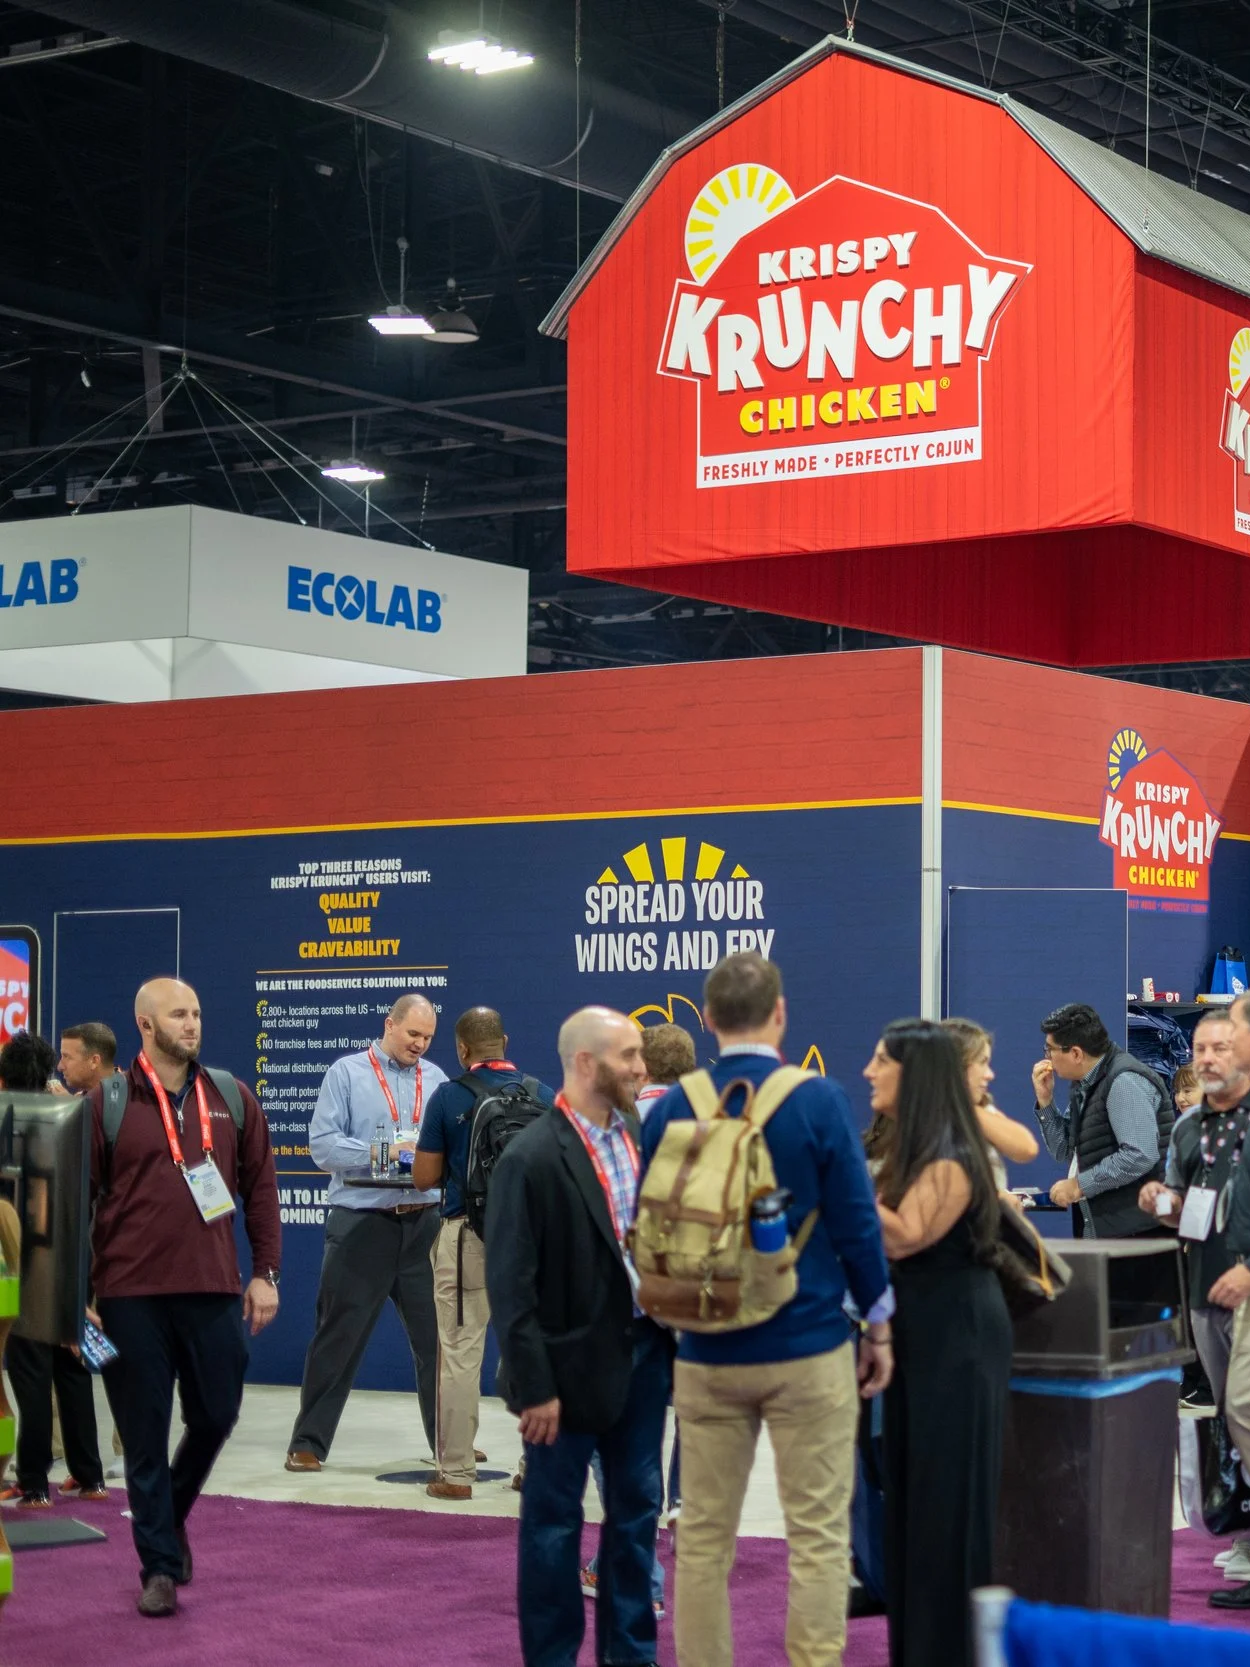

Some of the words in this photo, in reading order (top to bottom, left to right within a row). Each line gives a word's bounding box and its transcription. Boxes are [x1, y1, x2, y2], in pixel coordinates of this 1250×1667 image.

[758, 231, 918, 287] KRISPY
[666, 264, 1016, 392] KRUNCHY
[703, 461, 769, 482] FRESHLY
[775, 456, 818, 475] MADE
[835, 445, 920, 469] PERFECTLY
[925, 438, 976, 461] CAJUN
[1135, 781, 1189, 805] KRISPY
[1102, 794, 1220, 865] KRUNCHY
[299, 863, 319, 875] TOP
[320, 861, 353, 874] THREE
[354, 858, 402, 872] REASONS
[270, 876, 309, 889] KRISPY
[365, 872, 399, 885] USERS
[400, 870, 431, 884] VISIT:
[319, 891, 380, 914] QUALITY
[584, 882, 686, 925] SPREAD
[691, 880, 764, 921] YOUR
[327, 917, 371, 934] VALUE
[298, 939, 401, 958] CRAVEABILITY
[575, 931, 658, 973] WINGS
[662, 930, 719, 971] AND
[256, 980, 269, 991] WE
[270, 979, 286, 991] ARE
[287, 979, 304, 991] THE
[304, 978, 362, 990] FOODSERVICE
[363, 977, 406, 989] SOLUTION
[407, 977, 425, 988] FOR
[426, 976, 447, 987] YOU:
[262, 1006, 287, 1018] 2,800+
[288, 1004, 319, 1016] locations
[320, 1006, 344, 1016] across
[345, 1003, 357, 1015] the
[358, 1004, 368, 1014] US
[376, 1003, 391, 1014] twic
[432, 1003, 442, 1013] he
[262, 1018, 277, 1029] next
[278, 1017, 305, 1028] chicken
[306, 1018, 319, 1030] guy
[262, 1039, 273, 1050] NO
[274, 1038, 306, 1049] franchise
[307, 1038, 322, 1049] fees
[323, 1037, 337, 1048] and
[338, 1038, 349, 1048] NO
[262, 1062, 290, 1073] National
[291, 1062, 330, 1073] distribution
[262, 1086, 278, 1099] High
[279, 1086, 298, 1099] profit
[262, 1101, 288, 1112] existing
[268, 1122, 307, 1132] est-in-class
[280, 1145, 292, 1155] the
[293, 1189, 310, 1205] TO
[314, 1189, 330, 1205] LE
[280, 1208, 325, 1224] OMING
